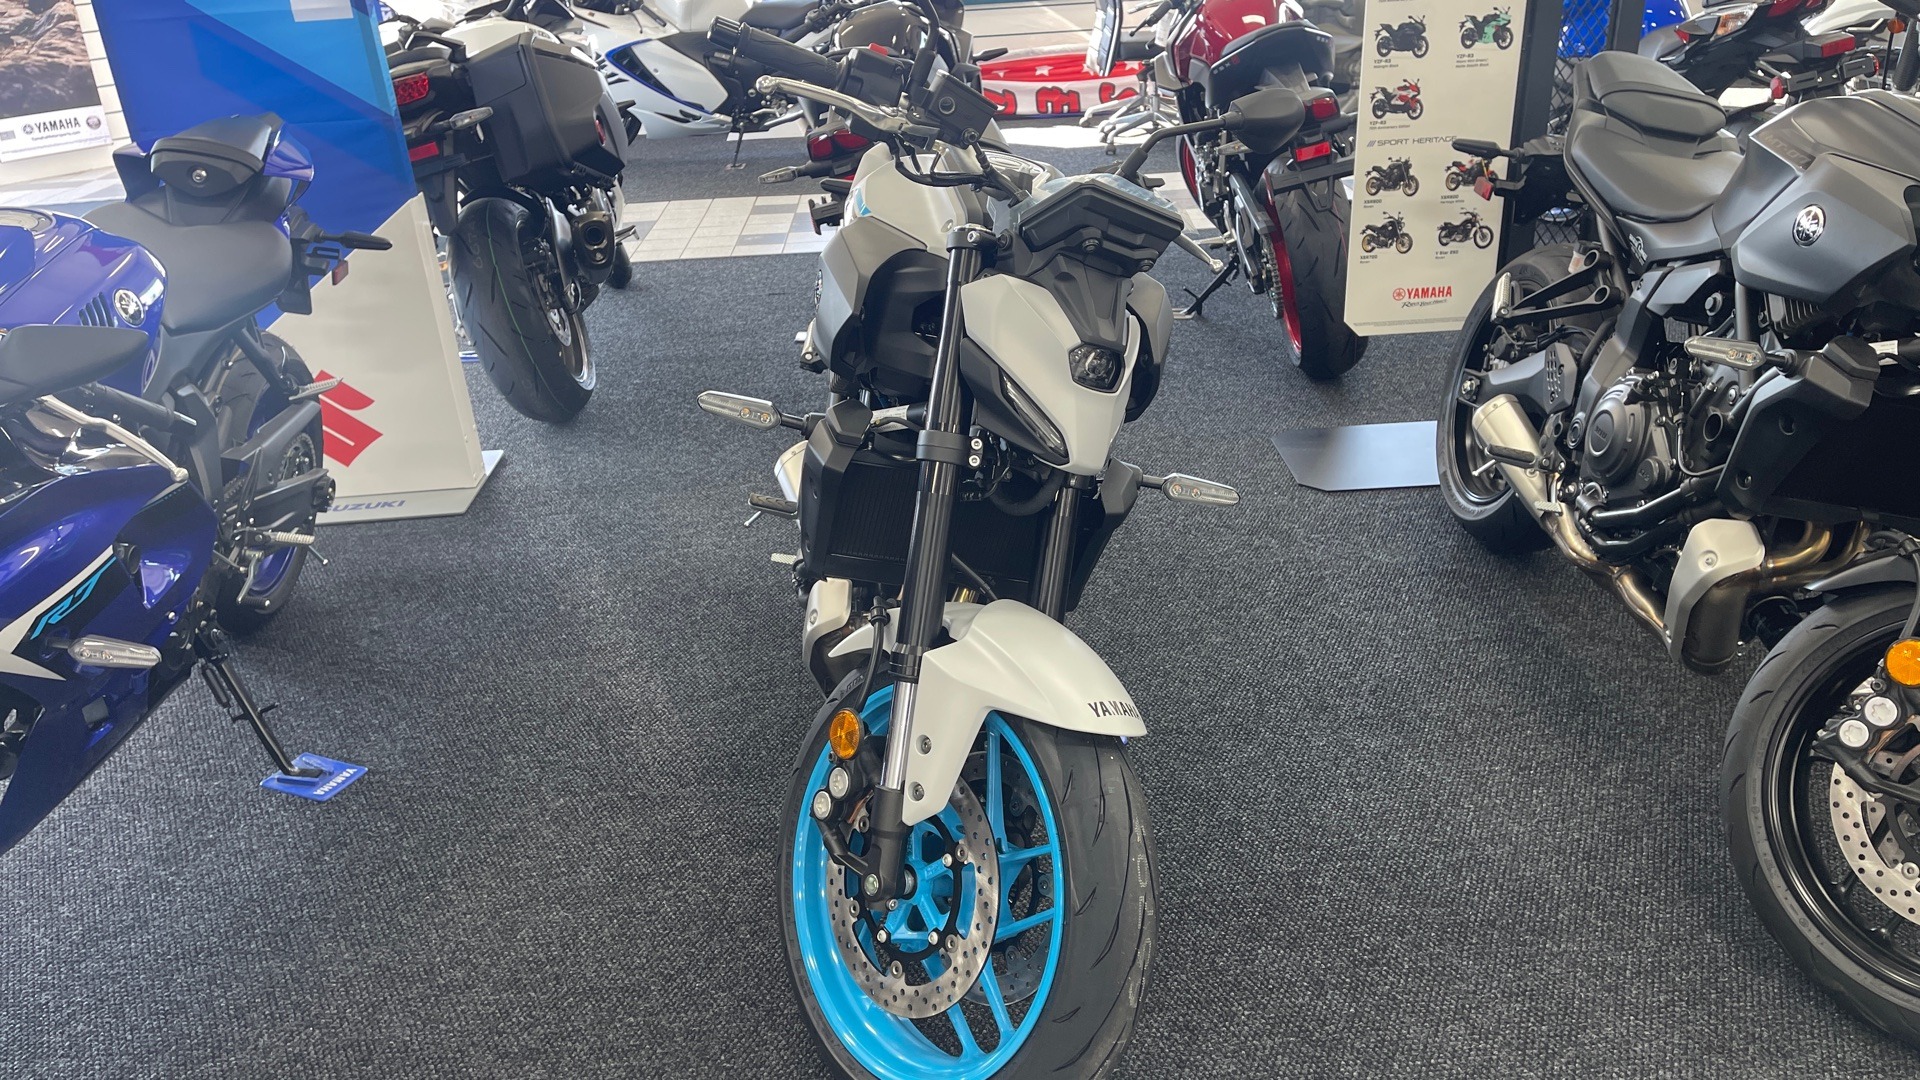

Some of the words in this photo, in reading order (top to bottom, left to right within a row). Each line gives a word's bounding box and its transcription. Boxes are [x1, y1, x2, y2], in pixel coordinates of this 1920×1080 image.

[35, 116, 81, 133] YAMAHA
[1377, 138, 1410, 147] SPORT
[1412, 135, 1458, 145] HERITAGE
[1406, 285, 1453, 300] YAMAHA
[30, 556, 117, 641] R7
[313, 768, 358, 796] YAMAHA
